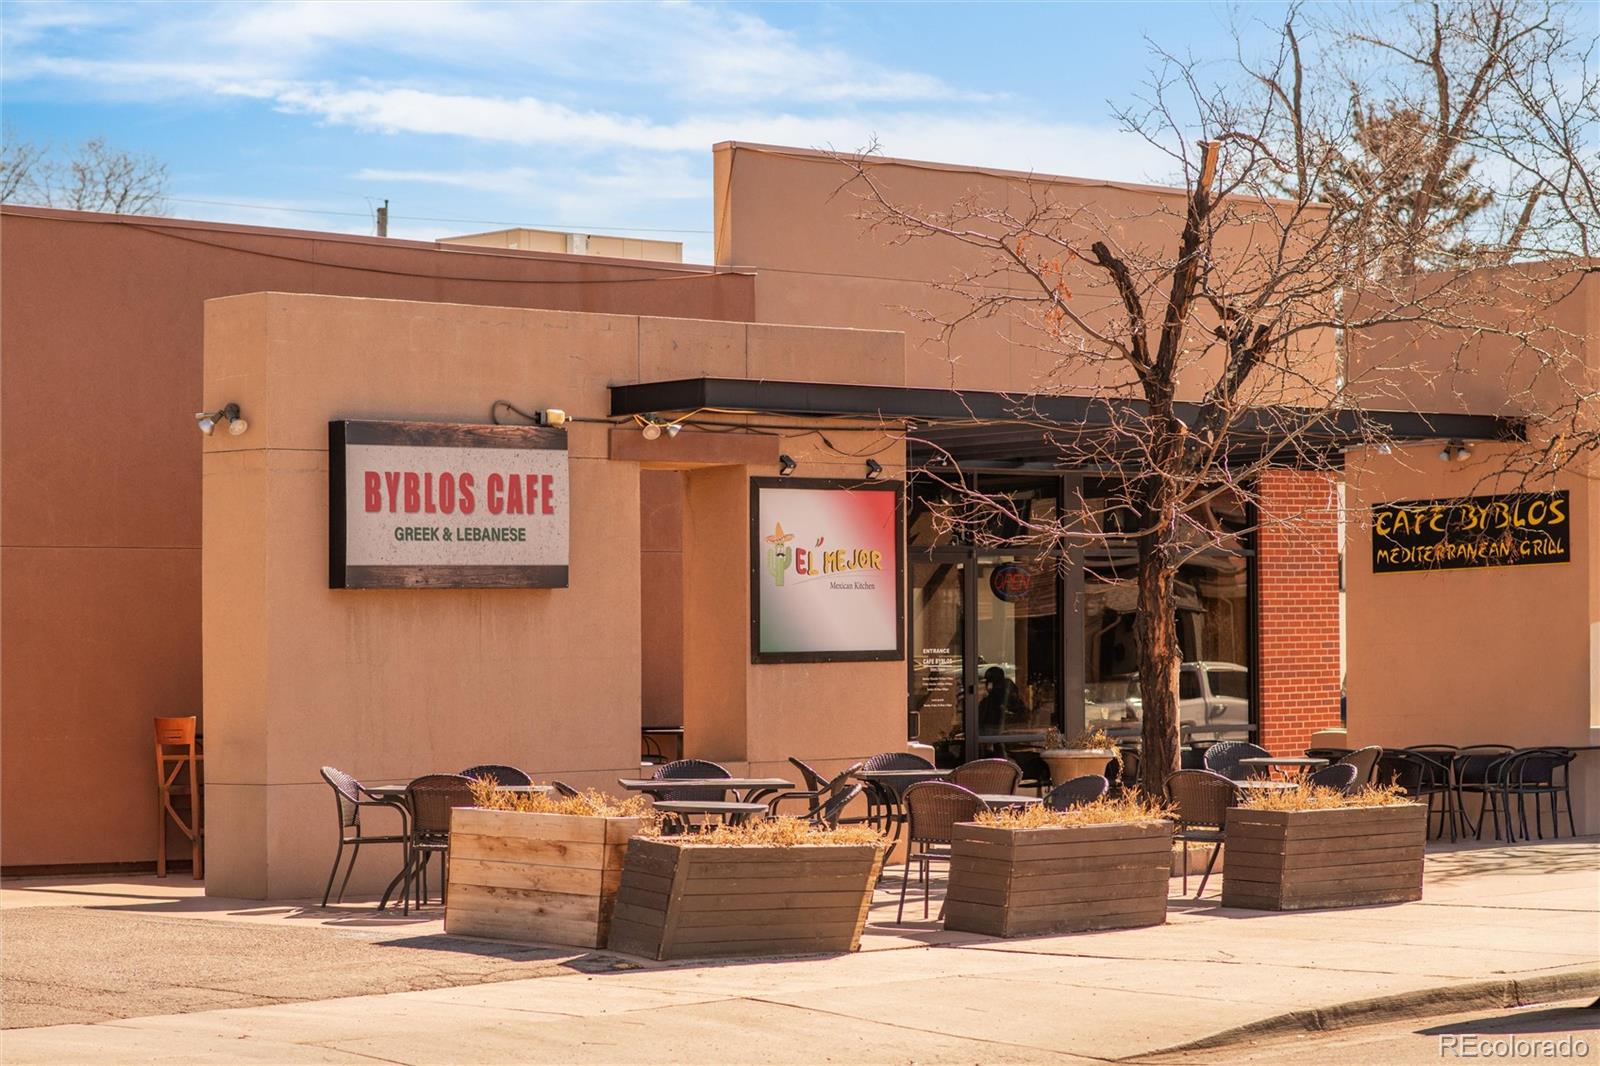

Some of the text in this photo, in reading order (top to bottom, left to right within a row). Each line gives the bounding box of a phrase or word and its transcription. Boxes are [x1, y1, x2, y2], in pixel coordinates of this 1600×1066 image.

[364, 471, 556, 516] BYBLOS CAFE
[1460, 499, 1566, 531] BYBLOS
[394, 527, 527, 542] GREEK & LEBANESE
[823, 548, 883, 574] MEJOR
[1376, 537, 1565, 565] MEDITERRANEAN GRILL
[829, 581, 876, 591] Mexican Kitchen
